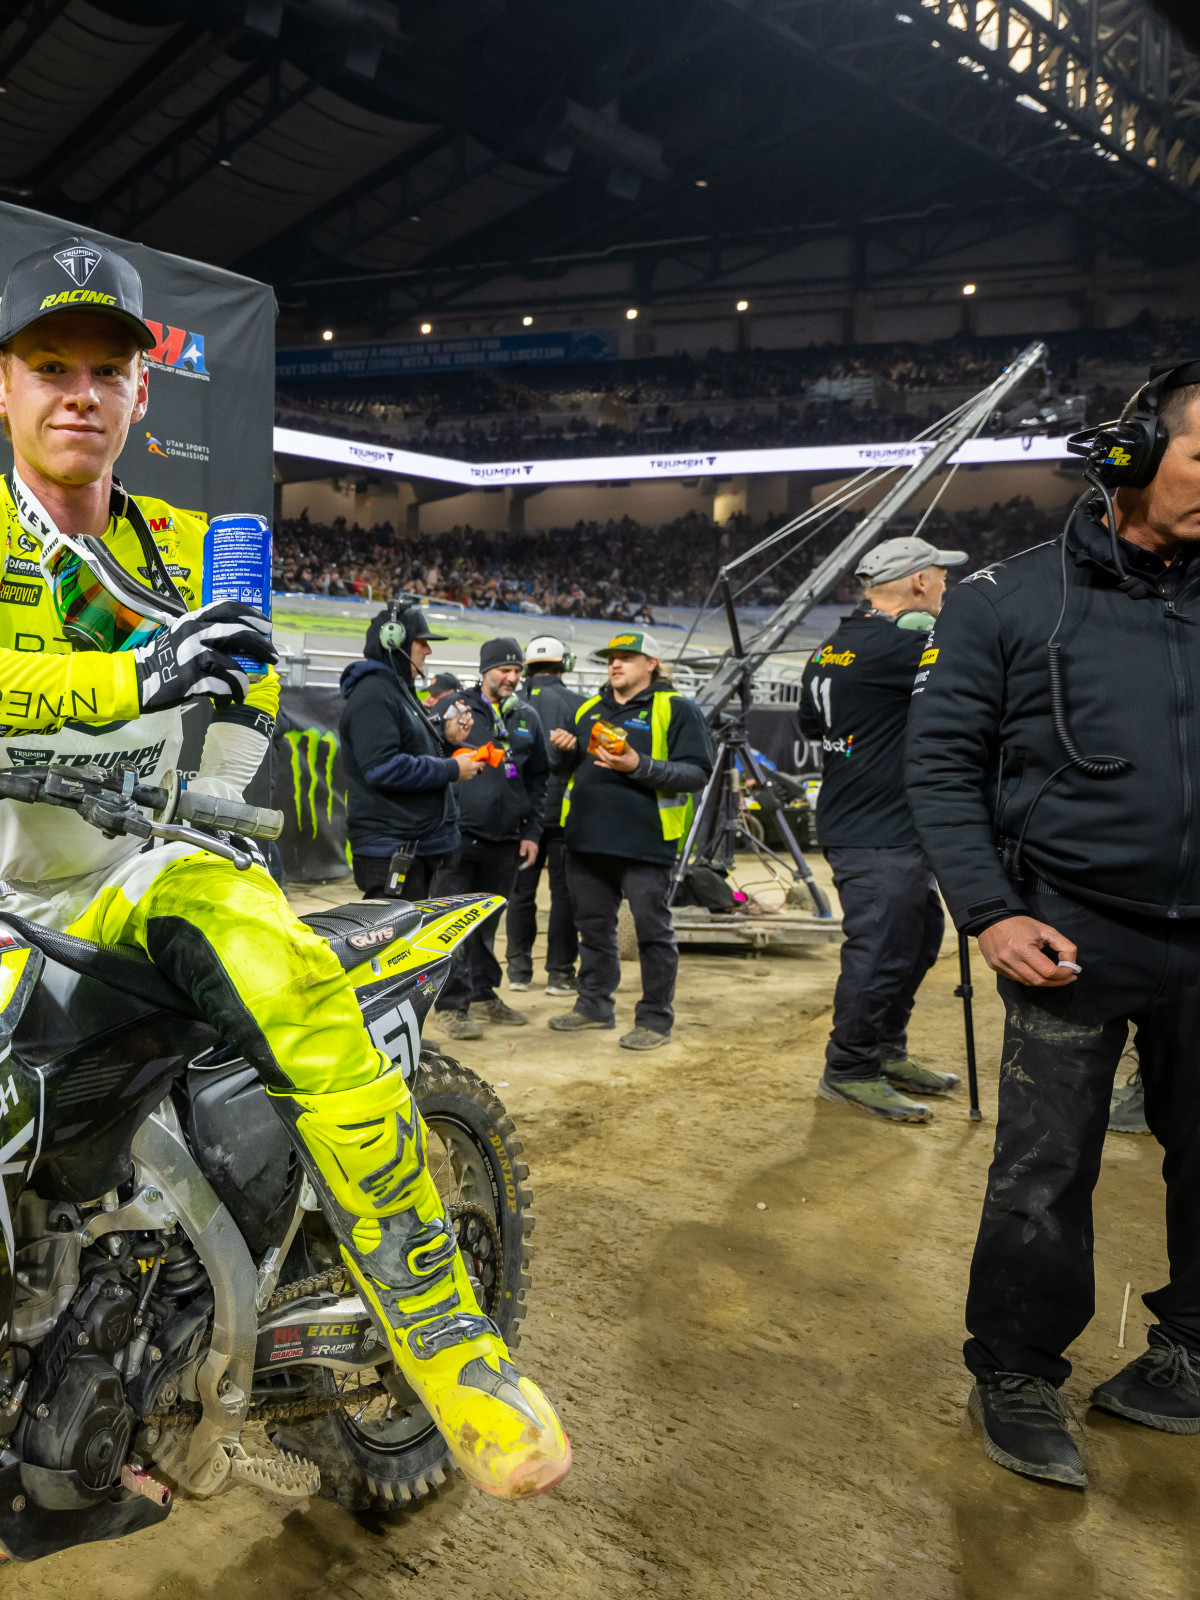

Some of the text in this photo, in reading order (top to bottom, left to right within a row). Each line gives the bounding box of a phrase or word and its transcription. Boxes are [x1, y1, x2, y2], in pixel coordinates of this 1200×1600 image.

[62, 249, 94, 258] TRIUMPH
[39, 289, 118, 311] RACING
[166, 439, 209, 454] UTAH SPORTS
[166, 448, 209, 461] COMMISSION
[349, 446, 385, 463] TRIUMPH
[471, 467, 520, 481] TRIUMPH
[650, 459, 703, 472] TRIUMPH
[12, 480, 50, 536] AKLEY
[820, 645, 856, 667] Sports
[810, 676, 832, 728] 11
[14, 751, 46, 759] TRIUMPH
[437, 908, 481, 944] DUNLOP
[350, 925, 395, 949] GUTS
[489, 1135, 517, 1213] DUNLOP
[274, 1323, 359, 1345] RK EXCEL
[270, 1348, 303, 1361] BRAKING
[318, 1342, 355, 1355] RAPTOR
